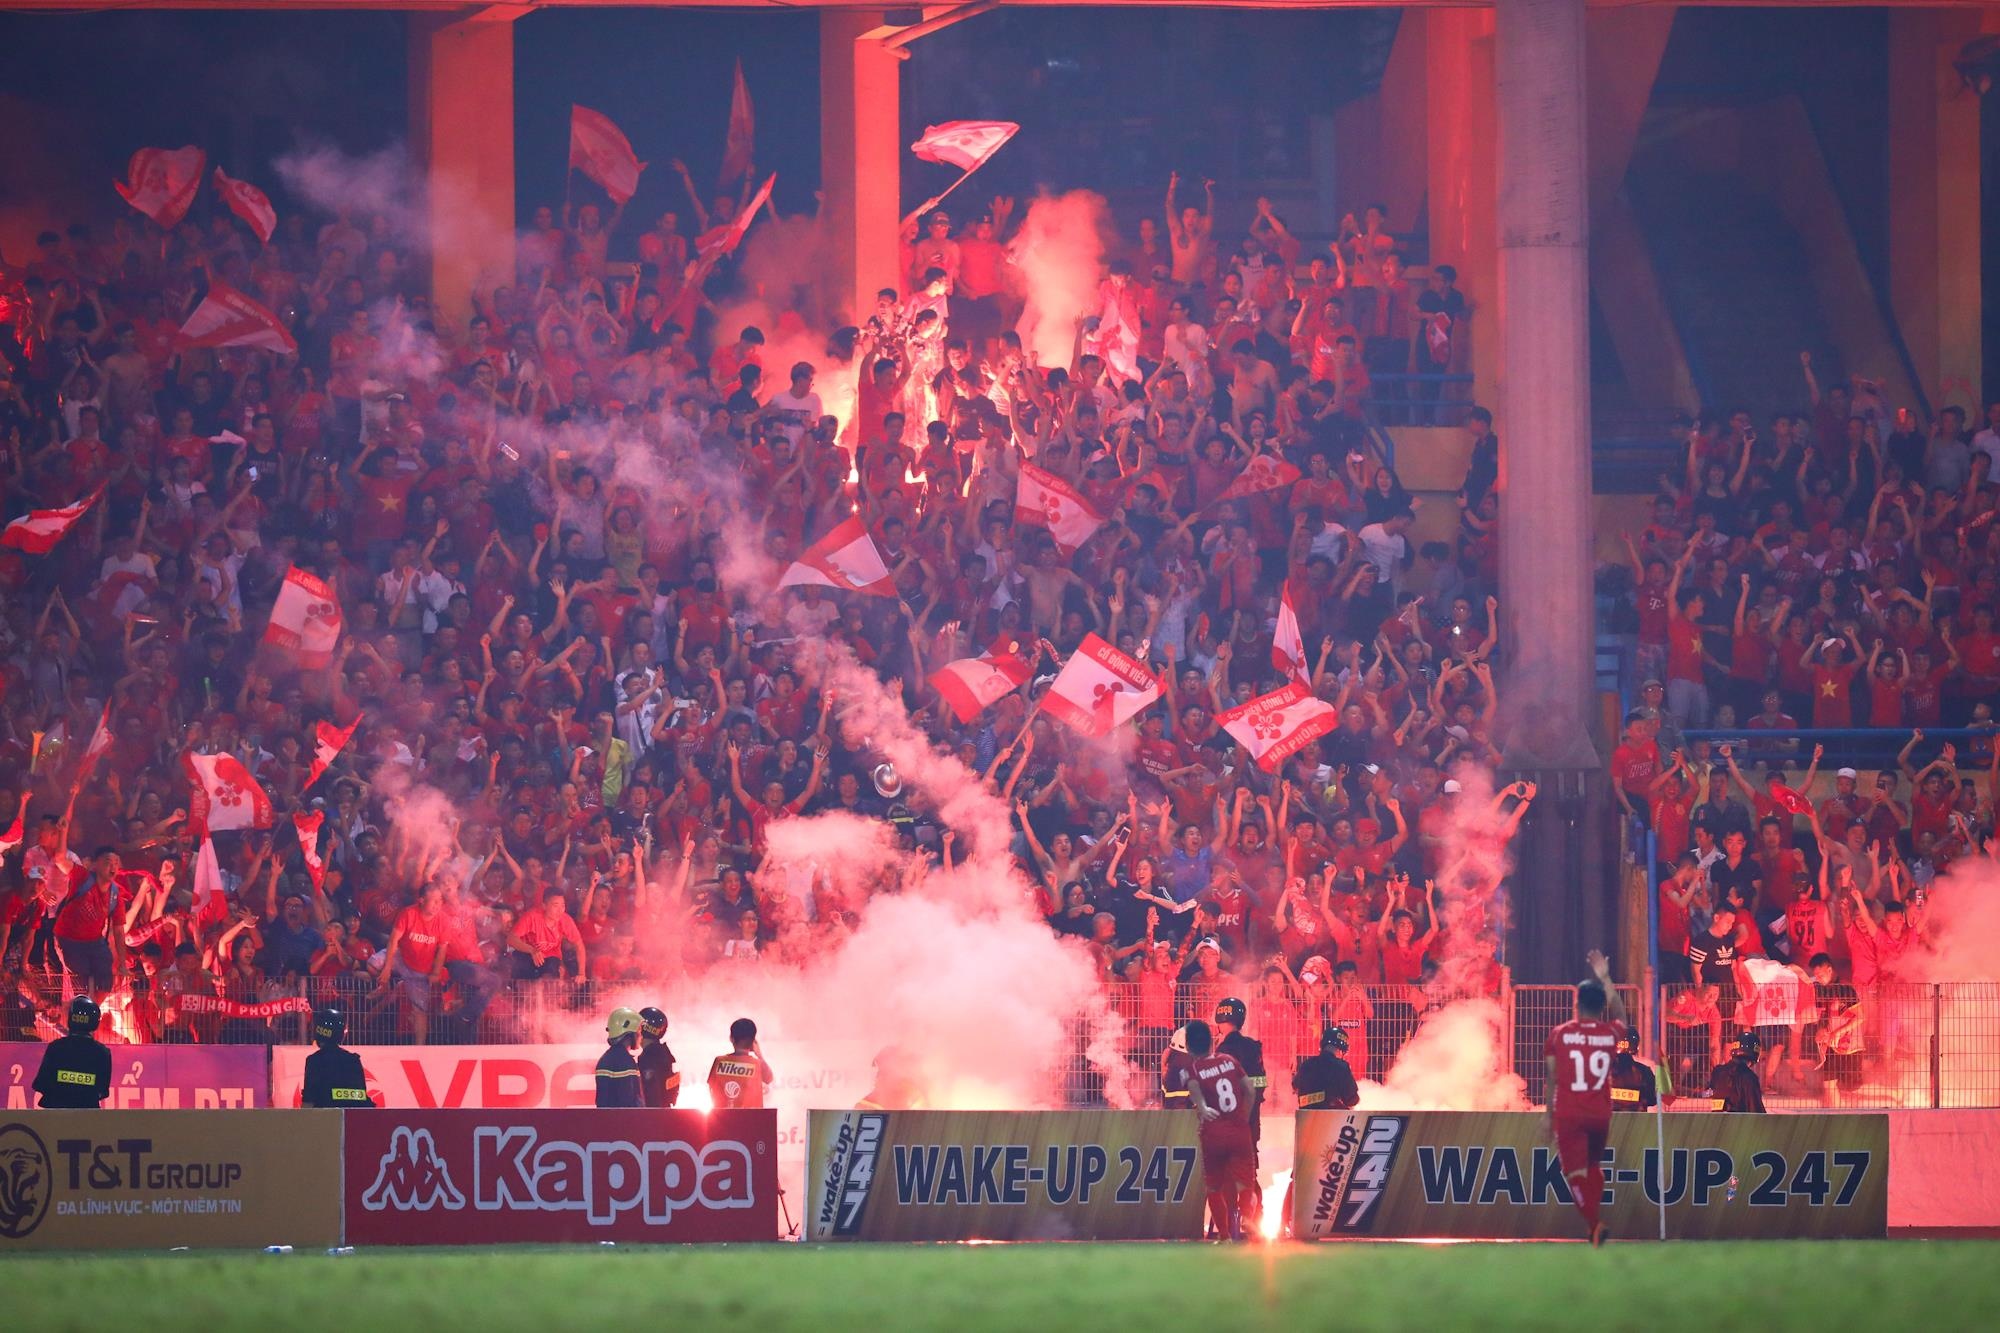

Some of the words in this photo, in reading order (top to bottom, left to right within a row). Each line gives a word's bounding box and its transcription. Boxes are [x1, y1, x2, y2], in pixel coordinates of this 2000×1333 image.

[716, 1062, 754, 1077] Nikon
[1569, 1050, 1611, 1092] 19
[1215, 1078, 1238, 1113] 8
[57, 1139, 153, 1190] T&T
[147, 1163, 242, 1190] GROUP
[473, 1126, 754, 1226] Kappa
[893, 1145, 1108, 1205] WAKE-UP
[1115, 1146, 1198, 1205] 247
[1748, 1150, 1873, 1207] 247
[57, 1201, 77, 1215] ĐA
[220, 1199, 242, 1213] TIN
